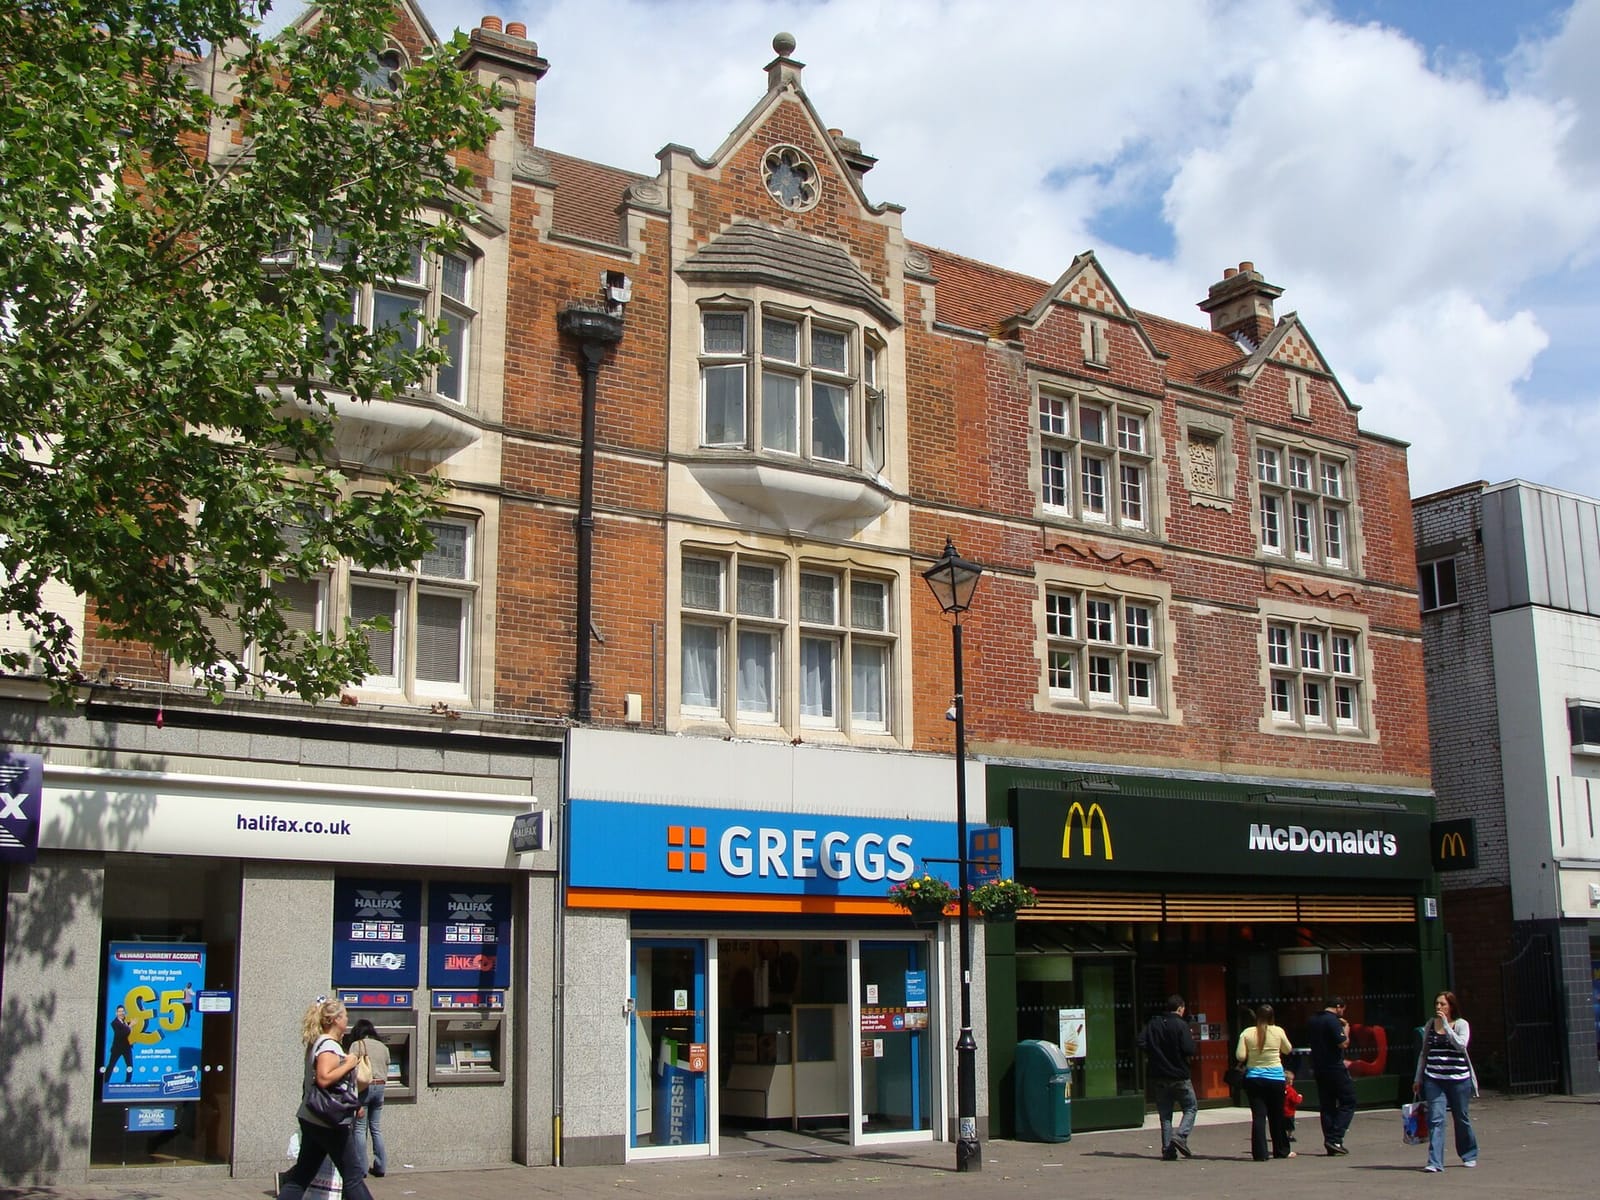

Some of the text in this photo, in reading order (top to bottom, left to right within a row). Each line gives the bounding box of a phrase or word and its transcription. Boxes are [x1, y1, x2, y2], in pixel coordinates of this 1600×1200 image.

[236, 813, 351, 836] halifax.co.uk
[1248, 822, 1397, 857] McDonald's
[719, 826, 915, 882] GREGGS
[354, 898, 402, 909] HALIFAX
[447, 901, 494, 912] HALIFAX
[124, 985, 187, 1045] £5
[669, 1084, 685, 1145] OFFERS
